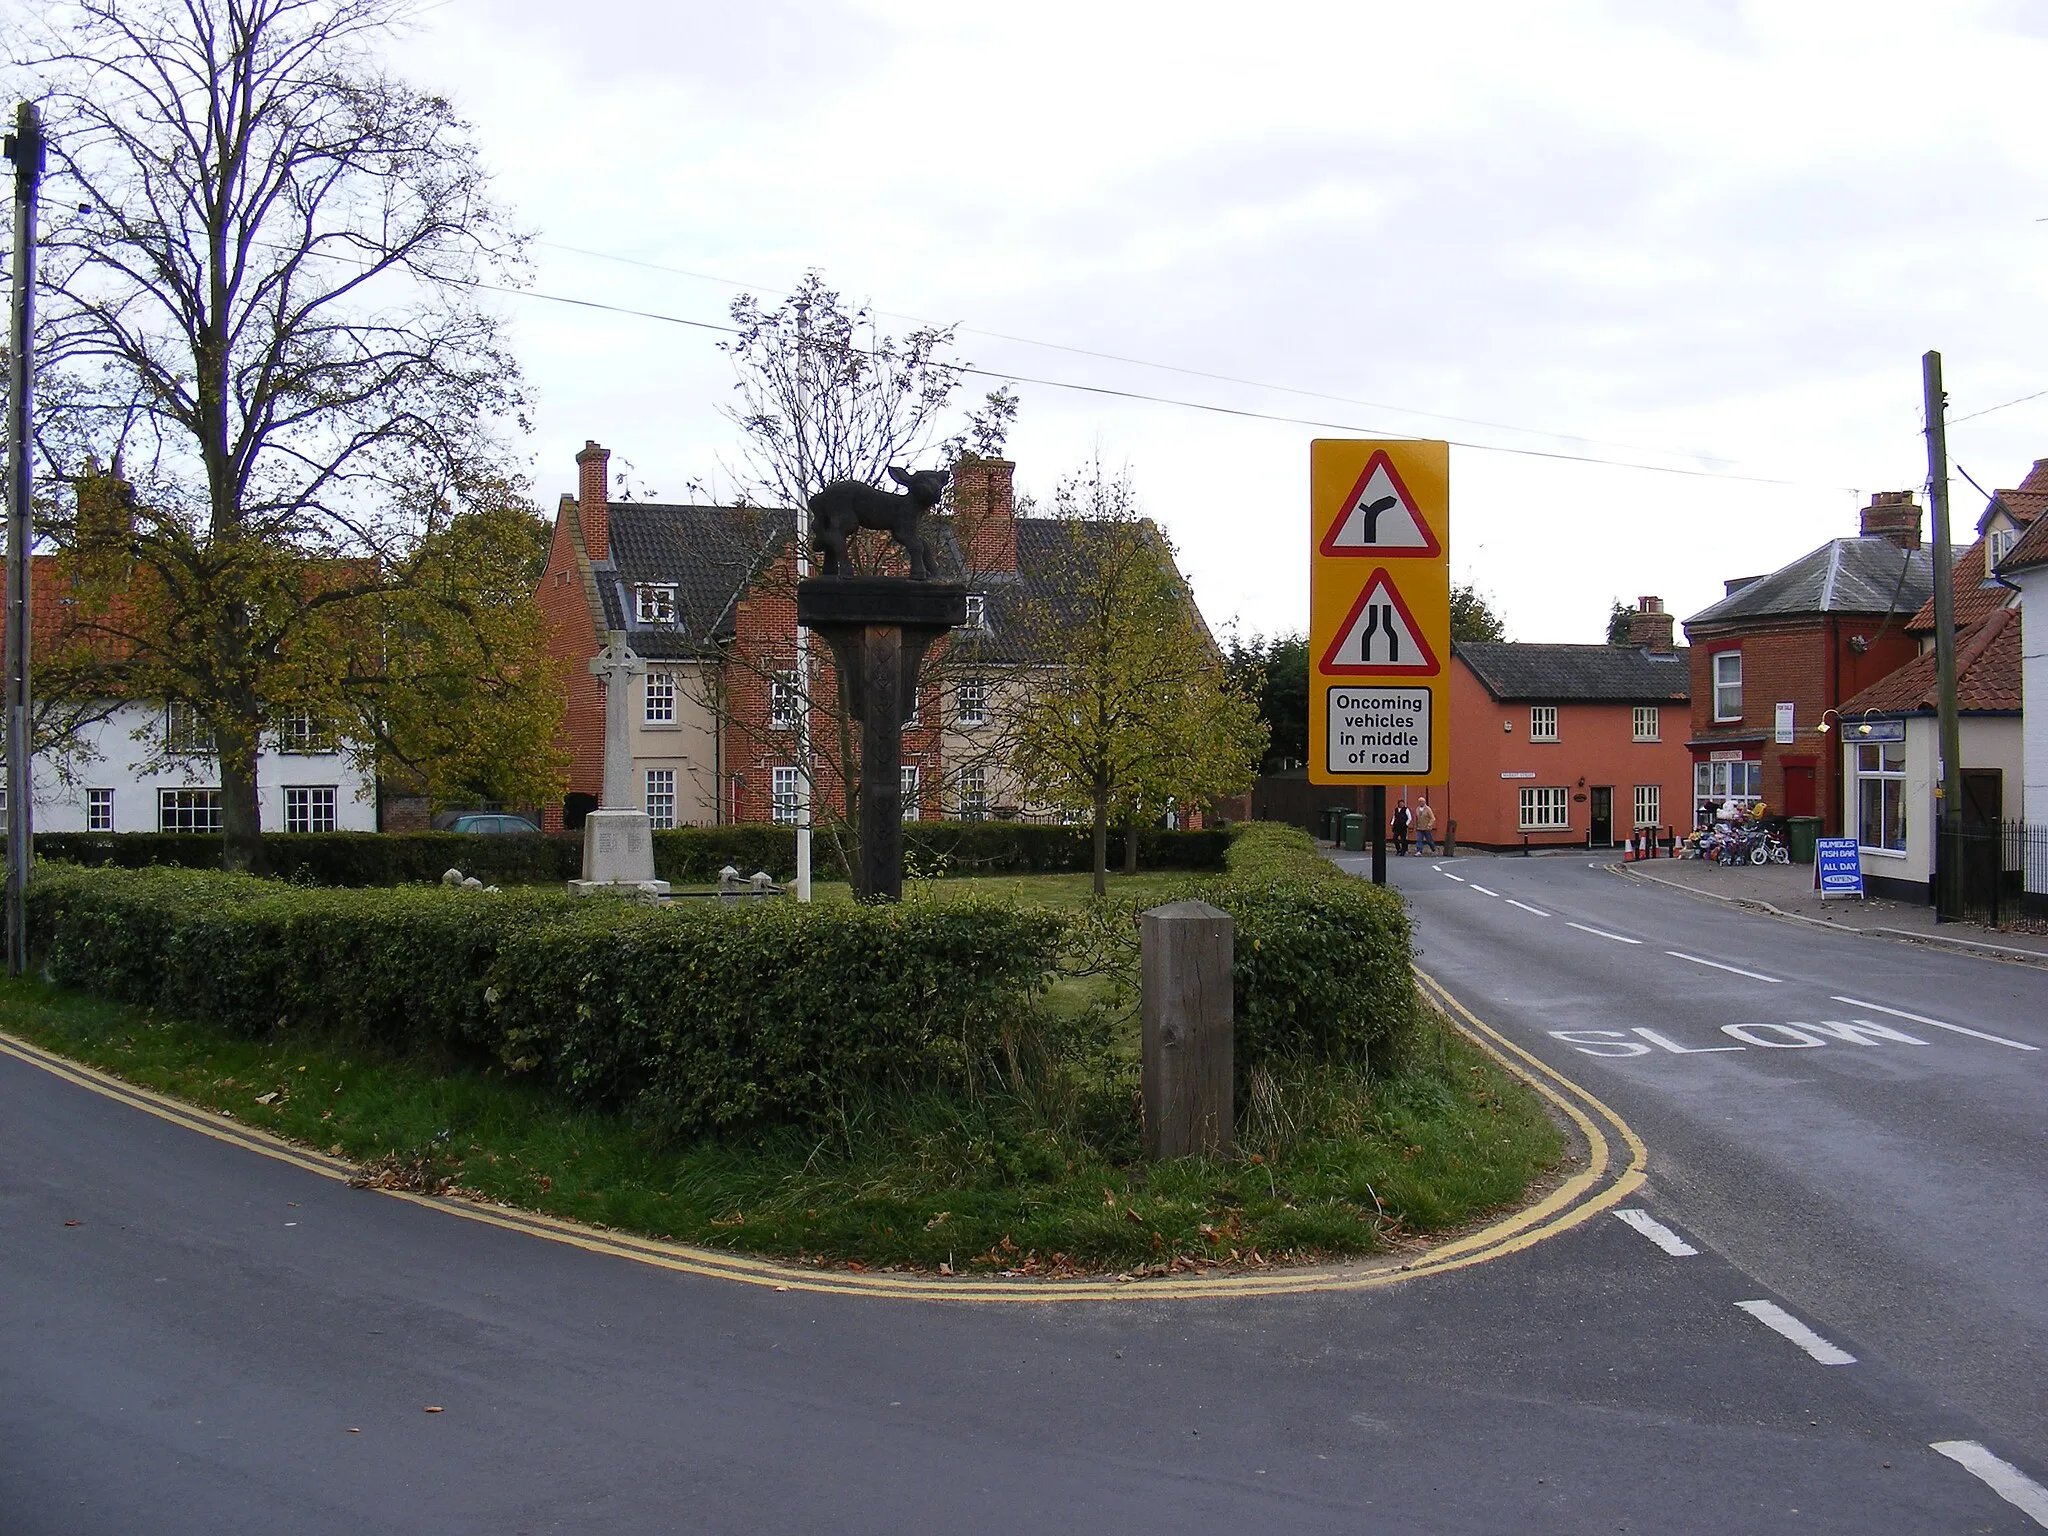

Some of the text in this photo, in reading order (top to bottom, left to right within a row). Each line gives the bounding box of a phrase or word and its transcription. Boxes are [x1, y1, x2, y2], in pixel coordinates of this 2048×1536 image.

[1337, 695, 1422, 712] Oncoming
[1345, 714, 1414, 728] vehicles
[1340, 732, 1418, 746] in middle
[1348, 750, 1409, 764] of road
[1548, 1019, 1931, 1058] SLOW
